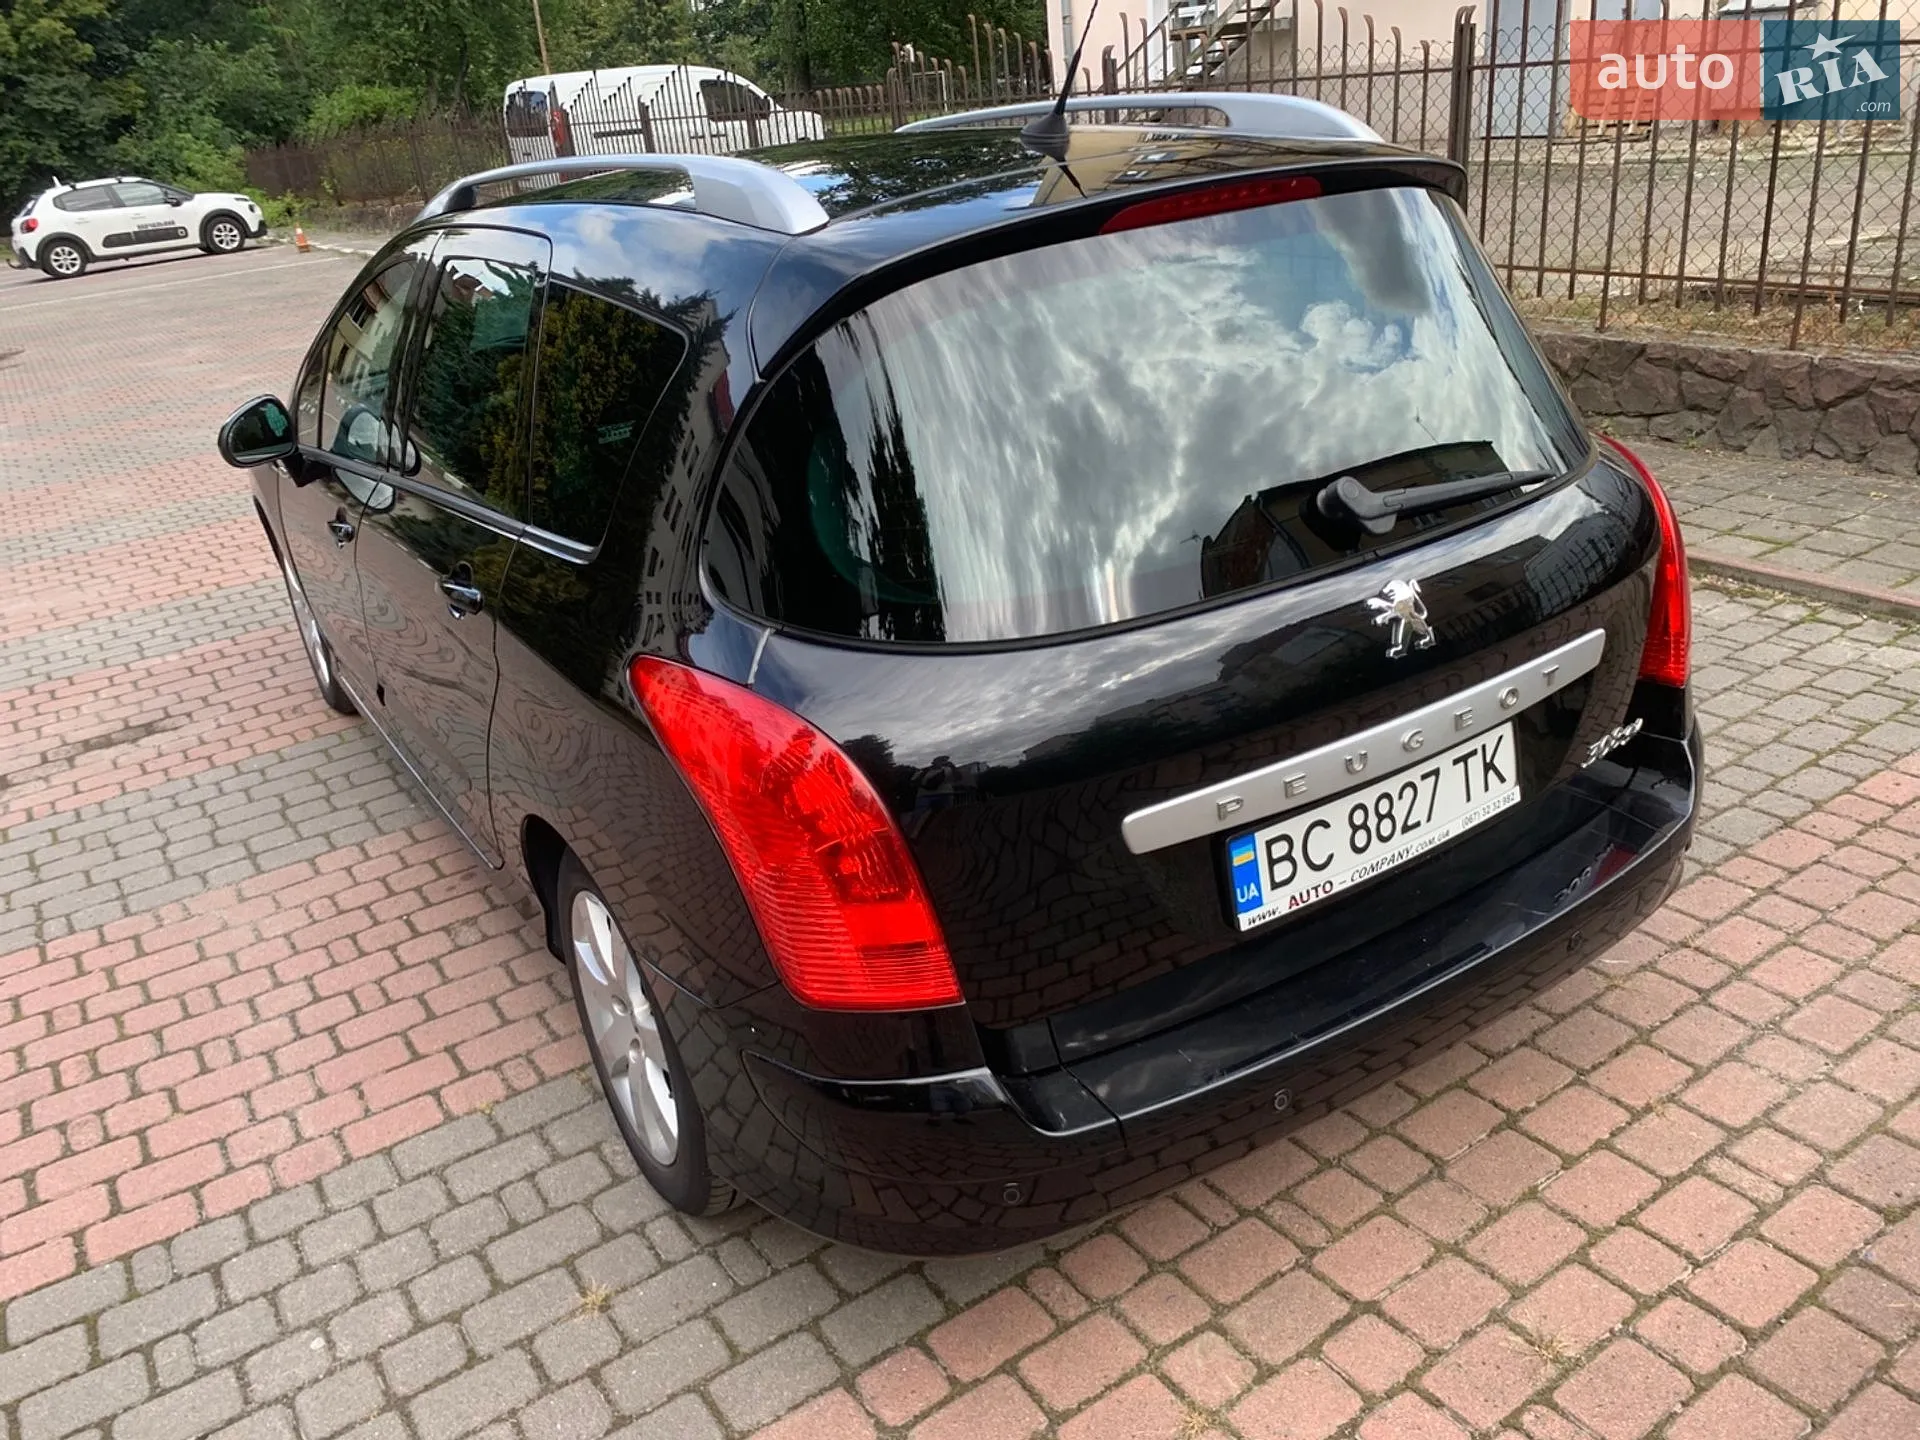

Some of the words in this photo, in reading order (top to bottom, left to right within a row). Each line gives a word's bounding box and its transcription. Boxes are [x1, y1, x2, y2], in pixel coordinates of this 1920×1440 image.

[1216, 664, 1560, 821] PEUGEOT
[1265, 819, 1335, 891] BC
[1348, 766, 1440, 855] 8827
[1453, 735, 1507, 803] TK
[1237, 882, 1260, 903] UA
[1288, 880, 1334, 909] AUTO
